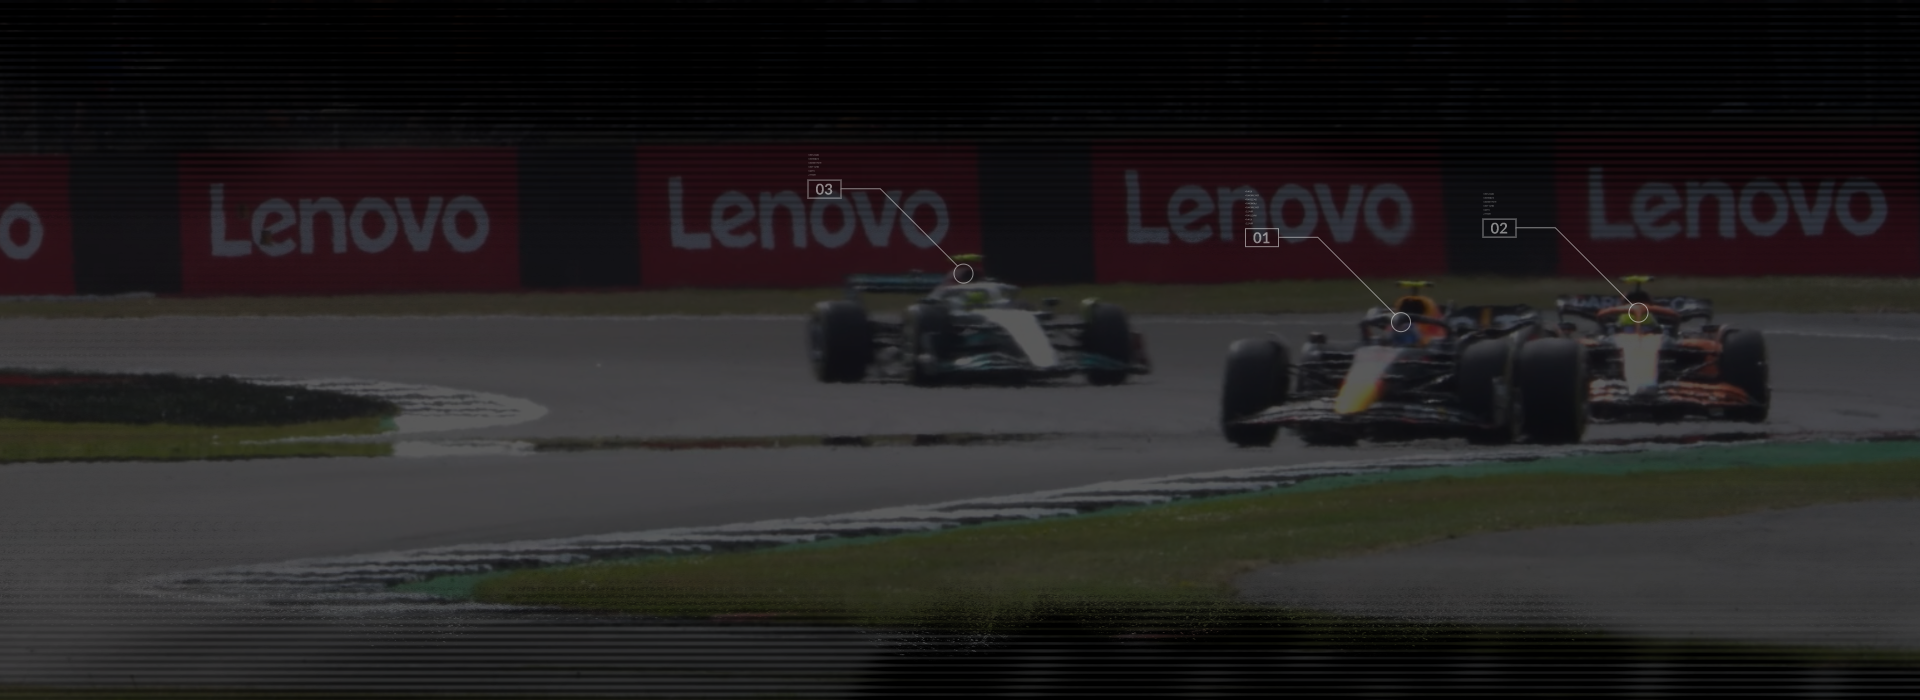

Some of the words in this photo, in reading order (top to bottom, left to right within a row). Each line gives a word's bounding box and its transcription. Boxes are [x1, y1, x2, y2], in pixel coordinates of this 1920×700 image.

[210, 182, 490, 257] Lenovo
[668, 175, 949, 250] Lenovo
[1124, 169, 1413, 245] Lenovo
[1588, 166, 1888, 241] Lenovo
